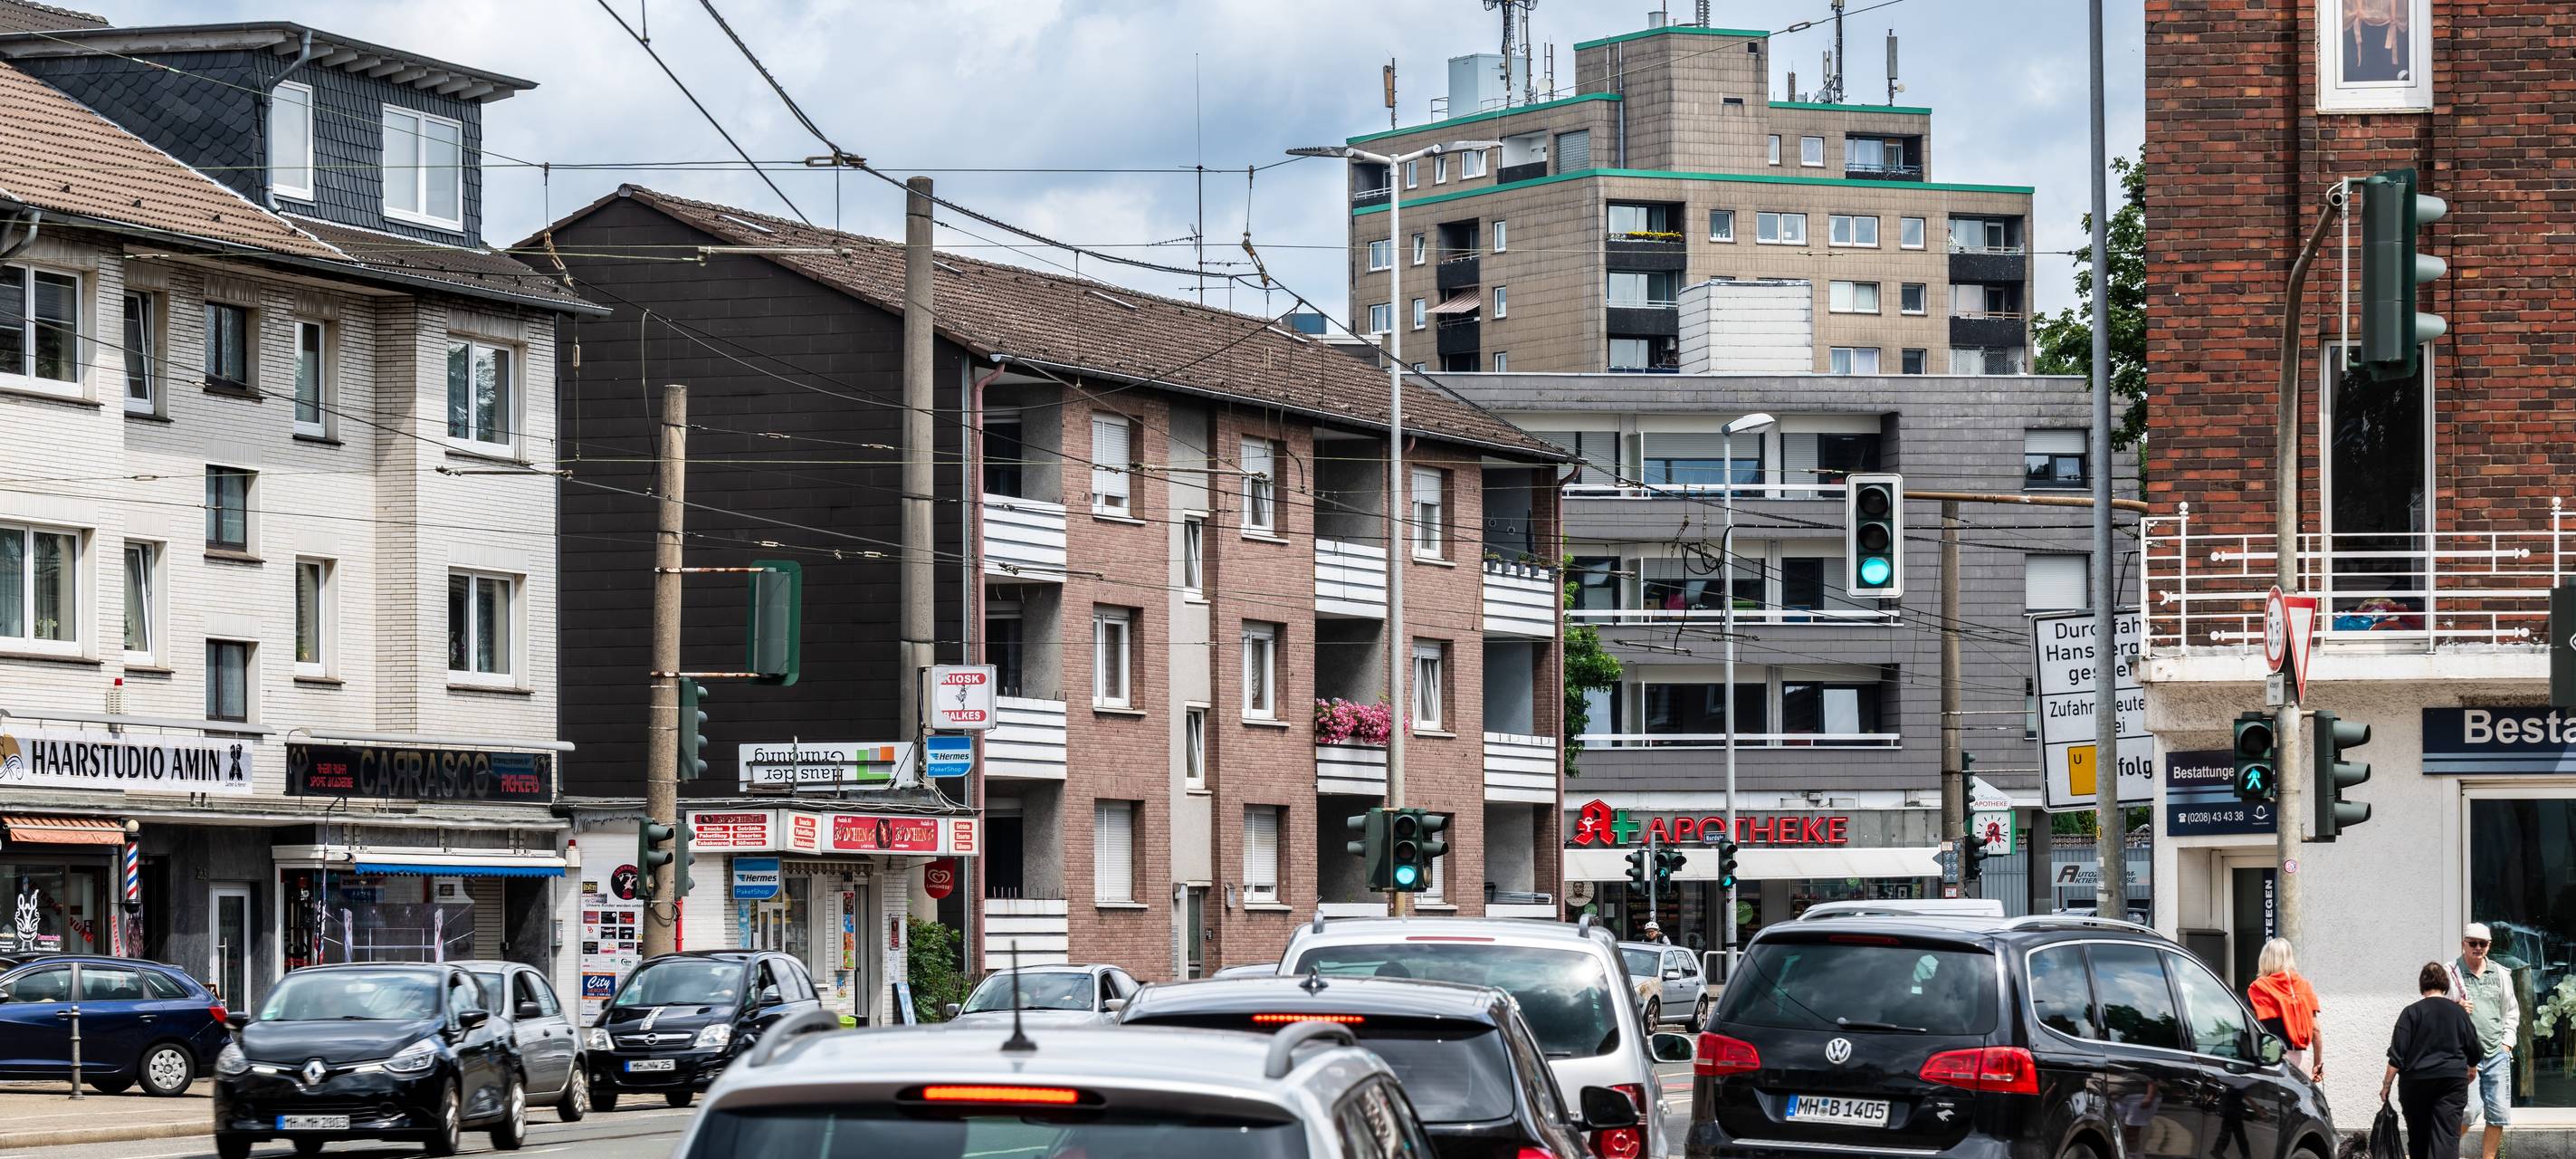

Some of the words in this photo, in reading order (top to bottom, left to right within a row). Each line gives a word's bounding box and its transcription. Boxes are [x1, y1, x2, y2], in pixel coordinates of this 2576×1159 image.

[943, 674, 980, 684] KIOSK
[2464, 709, 2576, 743] Besta
[32, 741, 165, 781] HAARSTUDIO
[171, 747, 220, 781] AMIN
[939, 752, 969, 761] Hermes
[359, 749, 490, 798] CARRASCO
[2173, 766, 2235, 781] Bestattunge
[2187, 811, 2211, 825] (0208)
[2212, 812, 2222, 822] 43
[2223, 811, 2233, 821] 43
[2235, 810, 2245, 821] 38
[1642, 816, 1849, 845] APOTHEKE
[745, 874, 778, 883] Hermes
[2265, 879, 2274, 943] STEEGEN
[587, 975, 611, 989] City
[1797, 1097, 1820, 1116] MH
[1829, 1099, 1840, 1116] B
[1843, 1100, 1886, 1120] 1405
